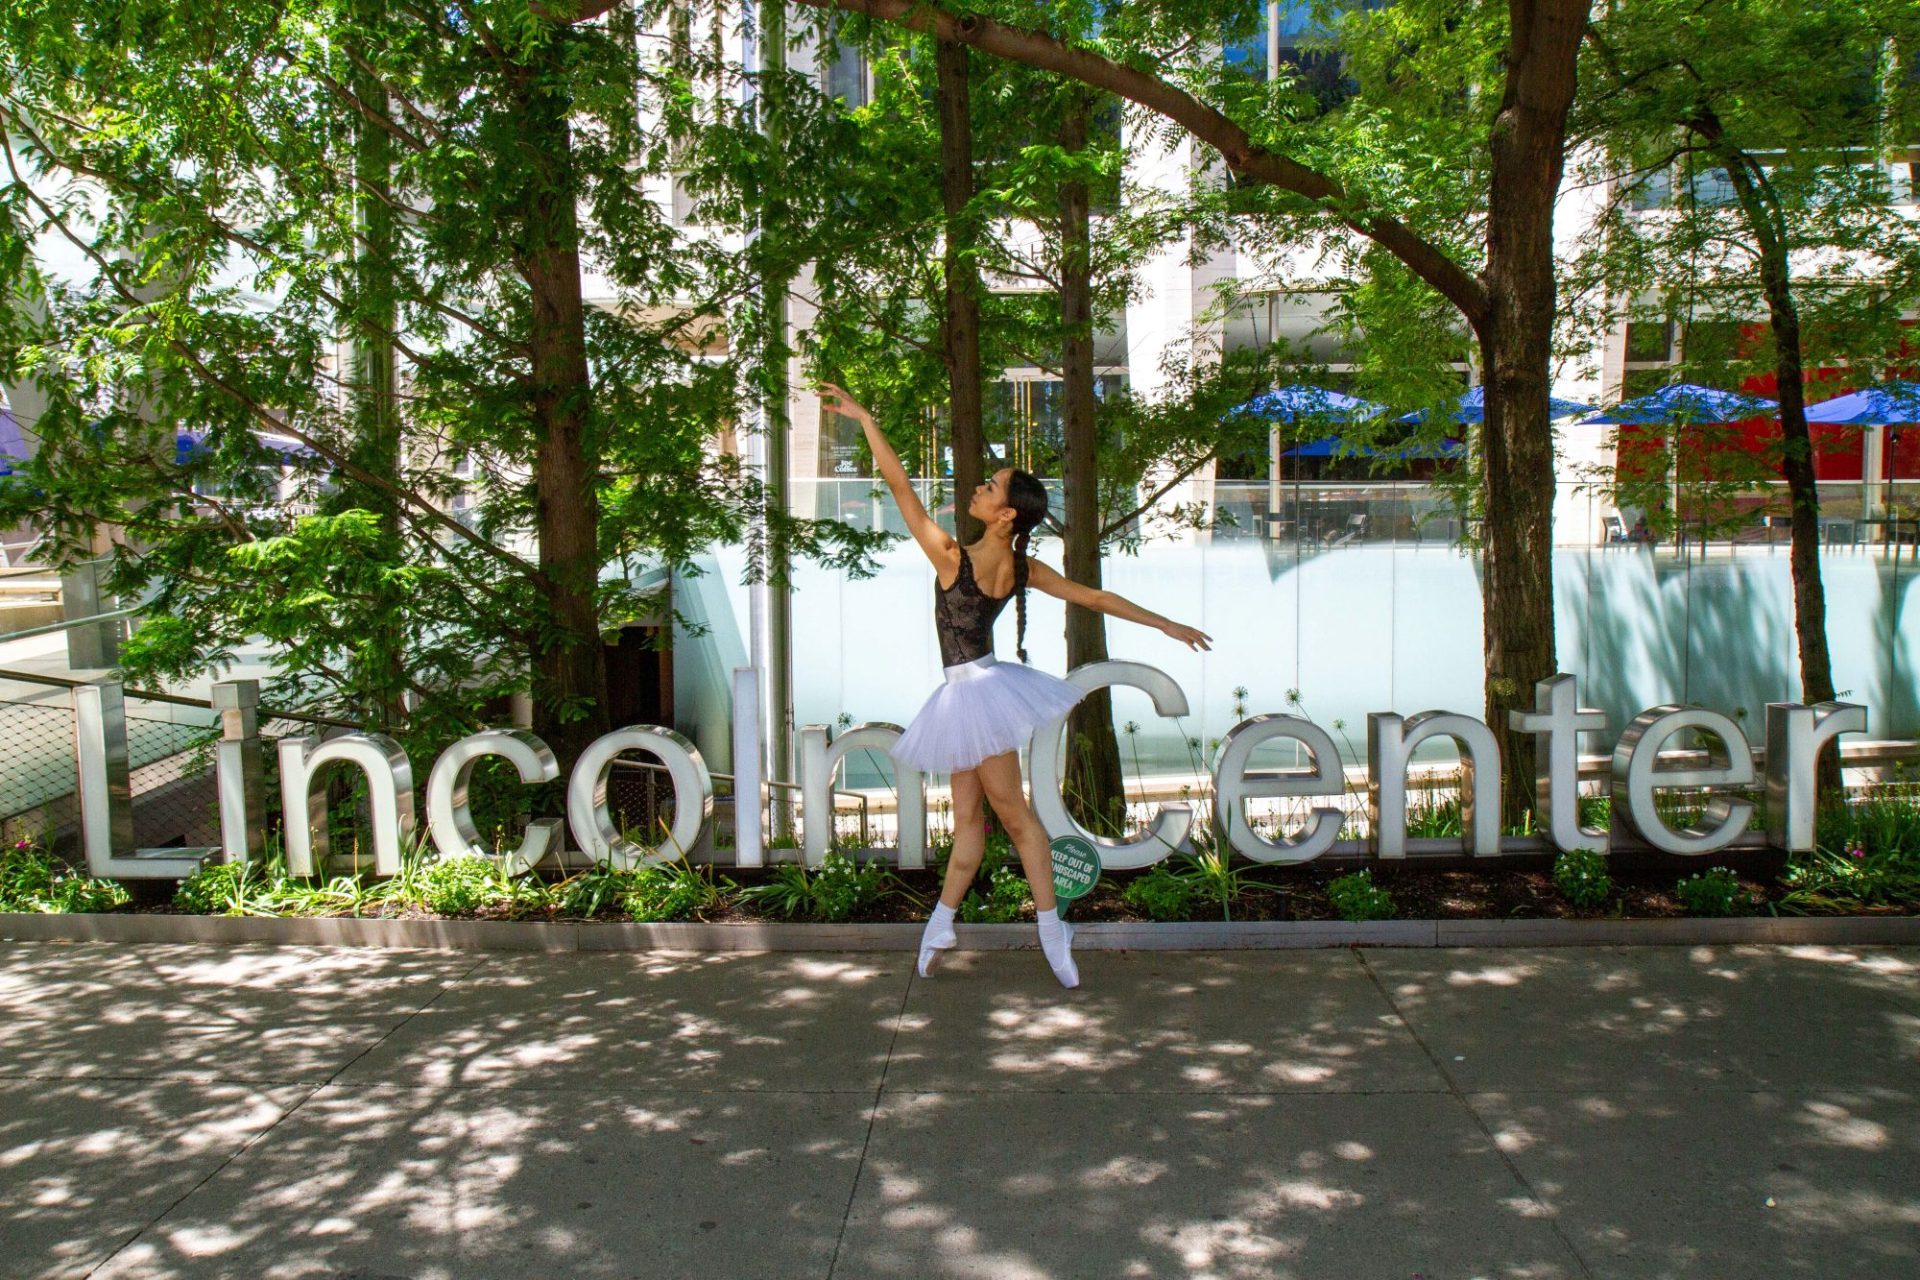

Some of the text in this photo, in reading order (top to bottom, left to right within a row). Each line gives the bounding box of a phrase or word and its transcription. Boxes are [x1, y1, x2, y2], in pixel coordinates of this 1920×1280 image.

[74, 659, 1868, 878] Lincoln Center
[1064, 843, 1087, 858] Please
[1051, 849, 1094, 874] KEEP OUT OF
[1054, 875, 1073, 889] AREA
